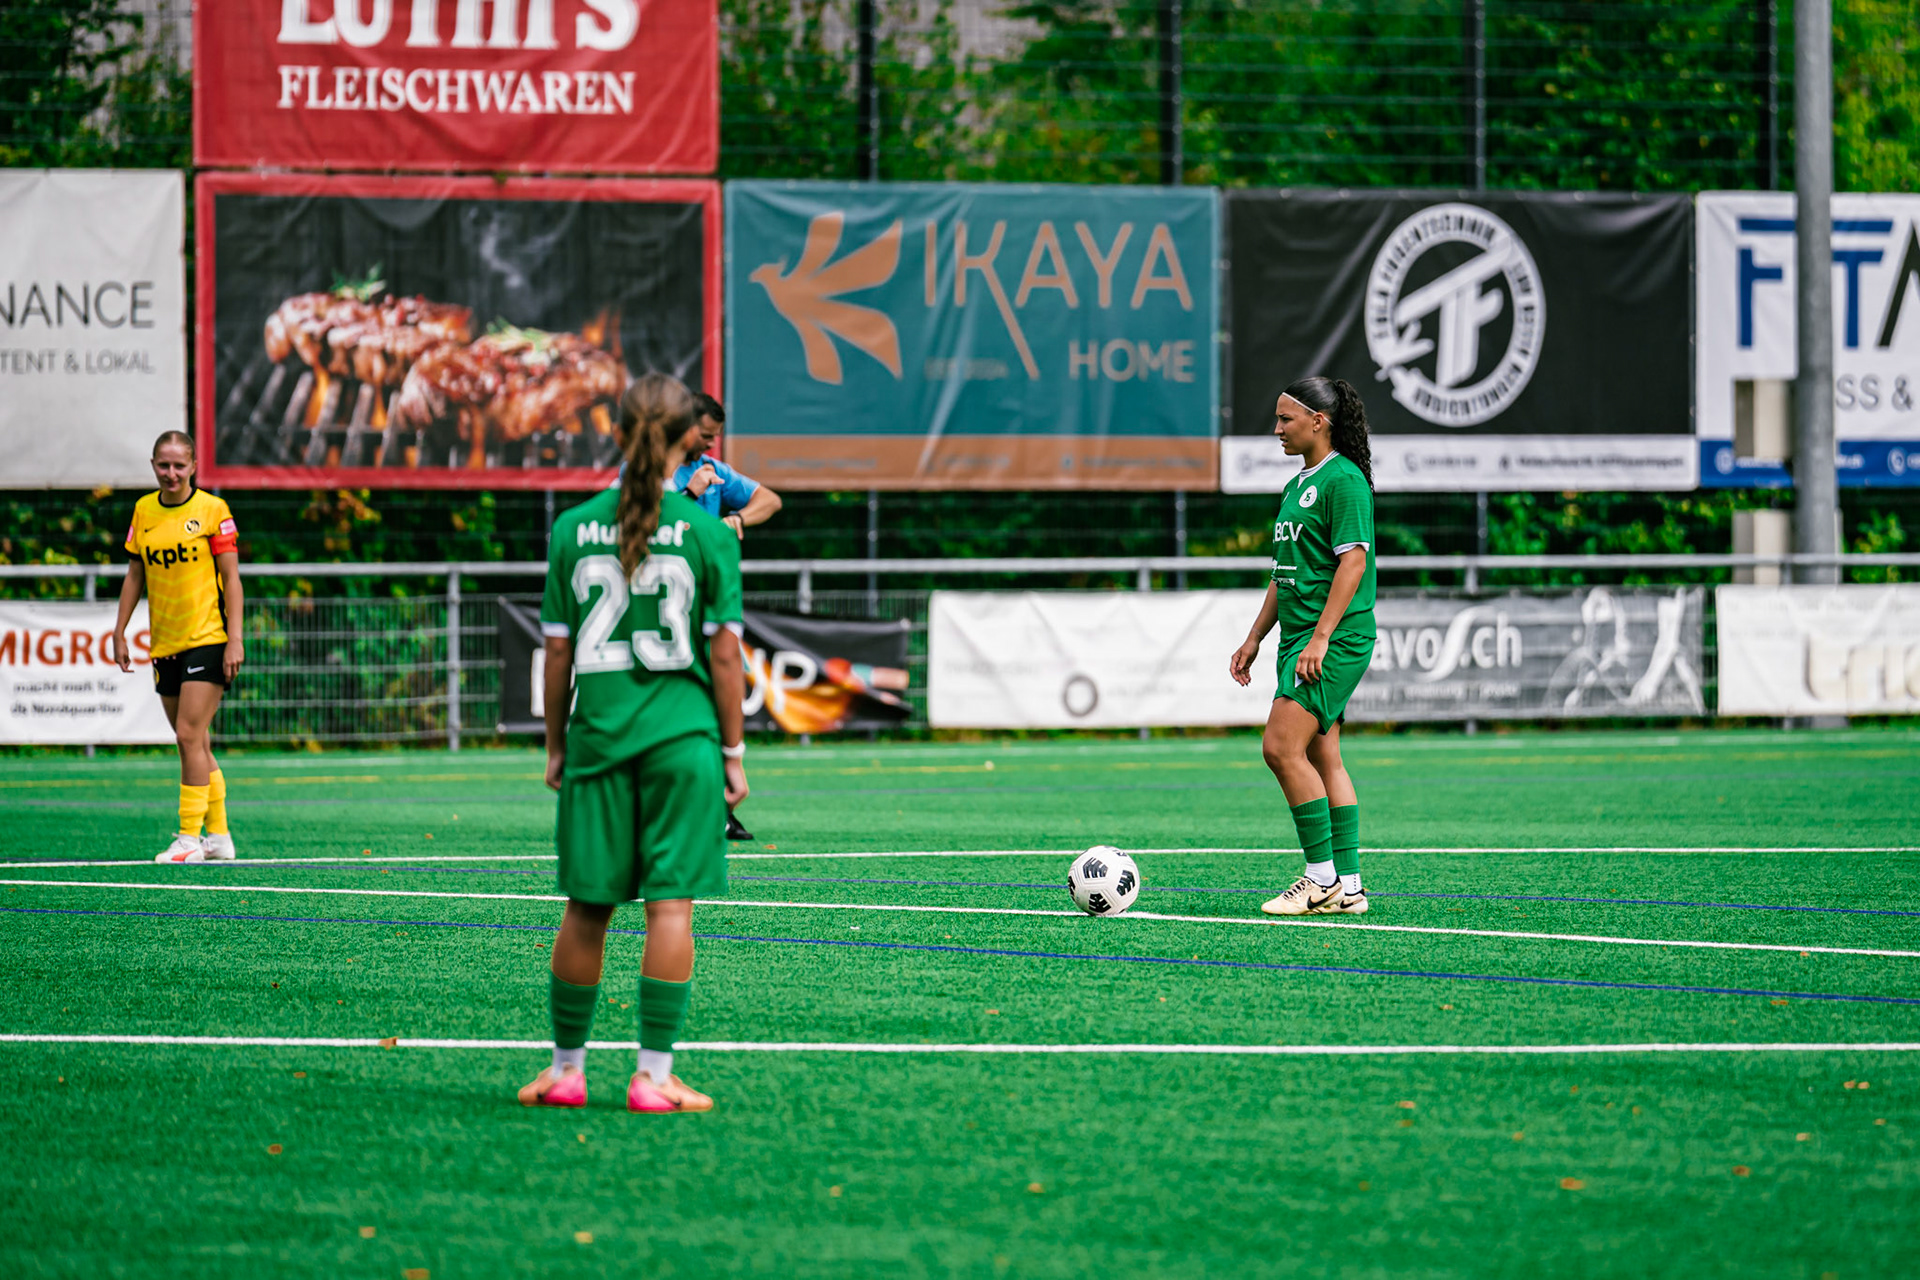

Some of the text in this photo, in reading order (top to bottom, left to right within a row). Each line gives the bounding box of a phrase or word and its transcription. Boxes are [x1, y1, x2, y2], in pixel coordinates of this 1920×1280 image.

[276, 64, 636, 115] FLEISCHWAREN
[924, 218, 1193, 381] IKAYA
[64, 350, 80, 375] &
[85, 349, 156, 375] LOKAL
[1068, 337, 1195, 383] HOME
[1891, 373, 1913, 411] &
[1274, 521, 1304, 542] BCV
[146, 543, 199, 569] kpt:
[571, 554, 696, 674] 23
